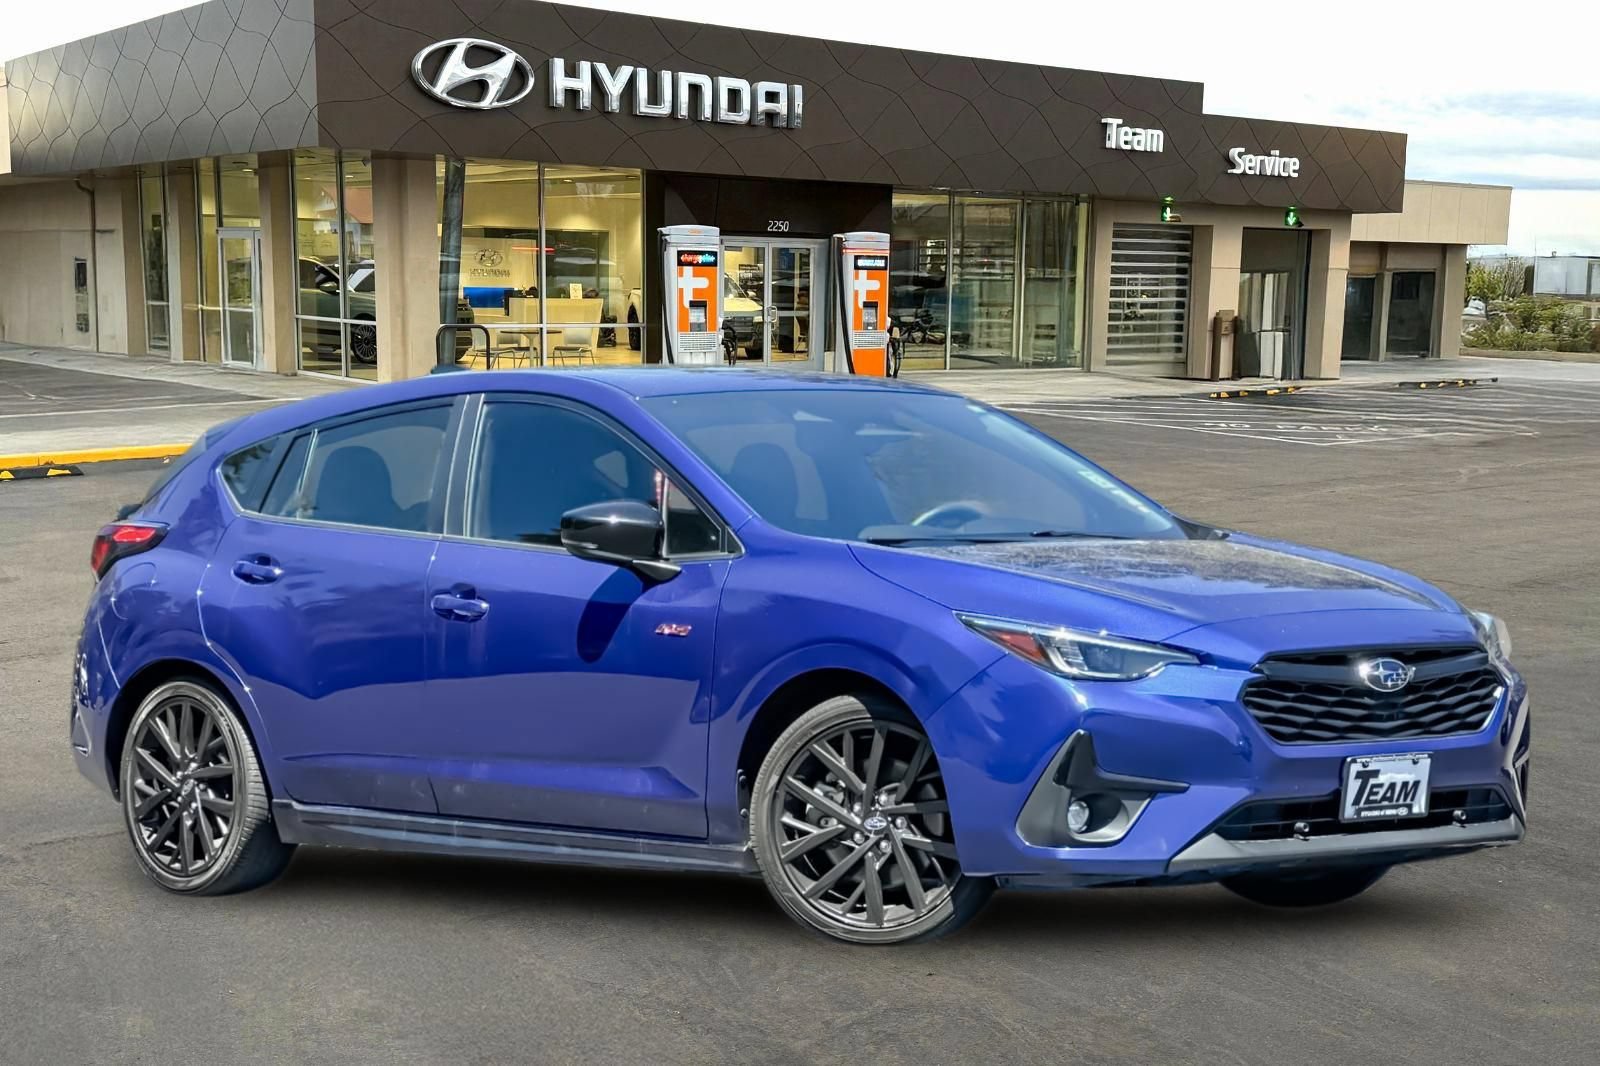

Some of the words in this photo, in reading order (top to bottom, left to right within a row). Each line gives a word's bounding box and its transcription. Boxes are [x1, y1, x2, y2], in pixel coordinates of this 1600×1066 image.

[549, 57, 803, 129] HYUNDAI
[1101, 117, 1164, 153] Team
[1227, 147, 1300, 178] Service
[767, 220, 790, 232] 2250
[1351, 769, 1421, 807] TEAM
